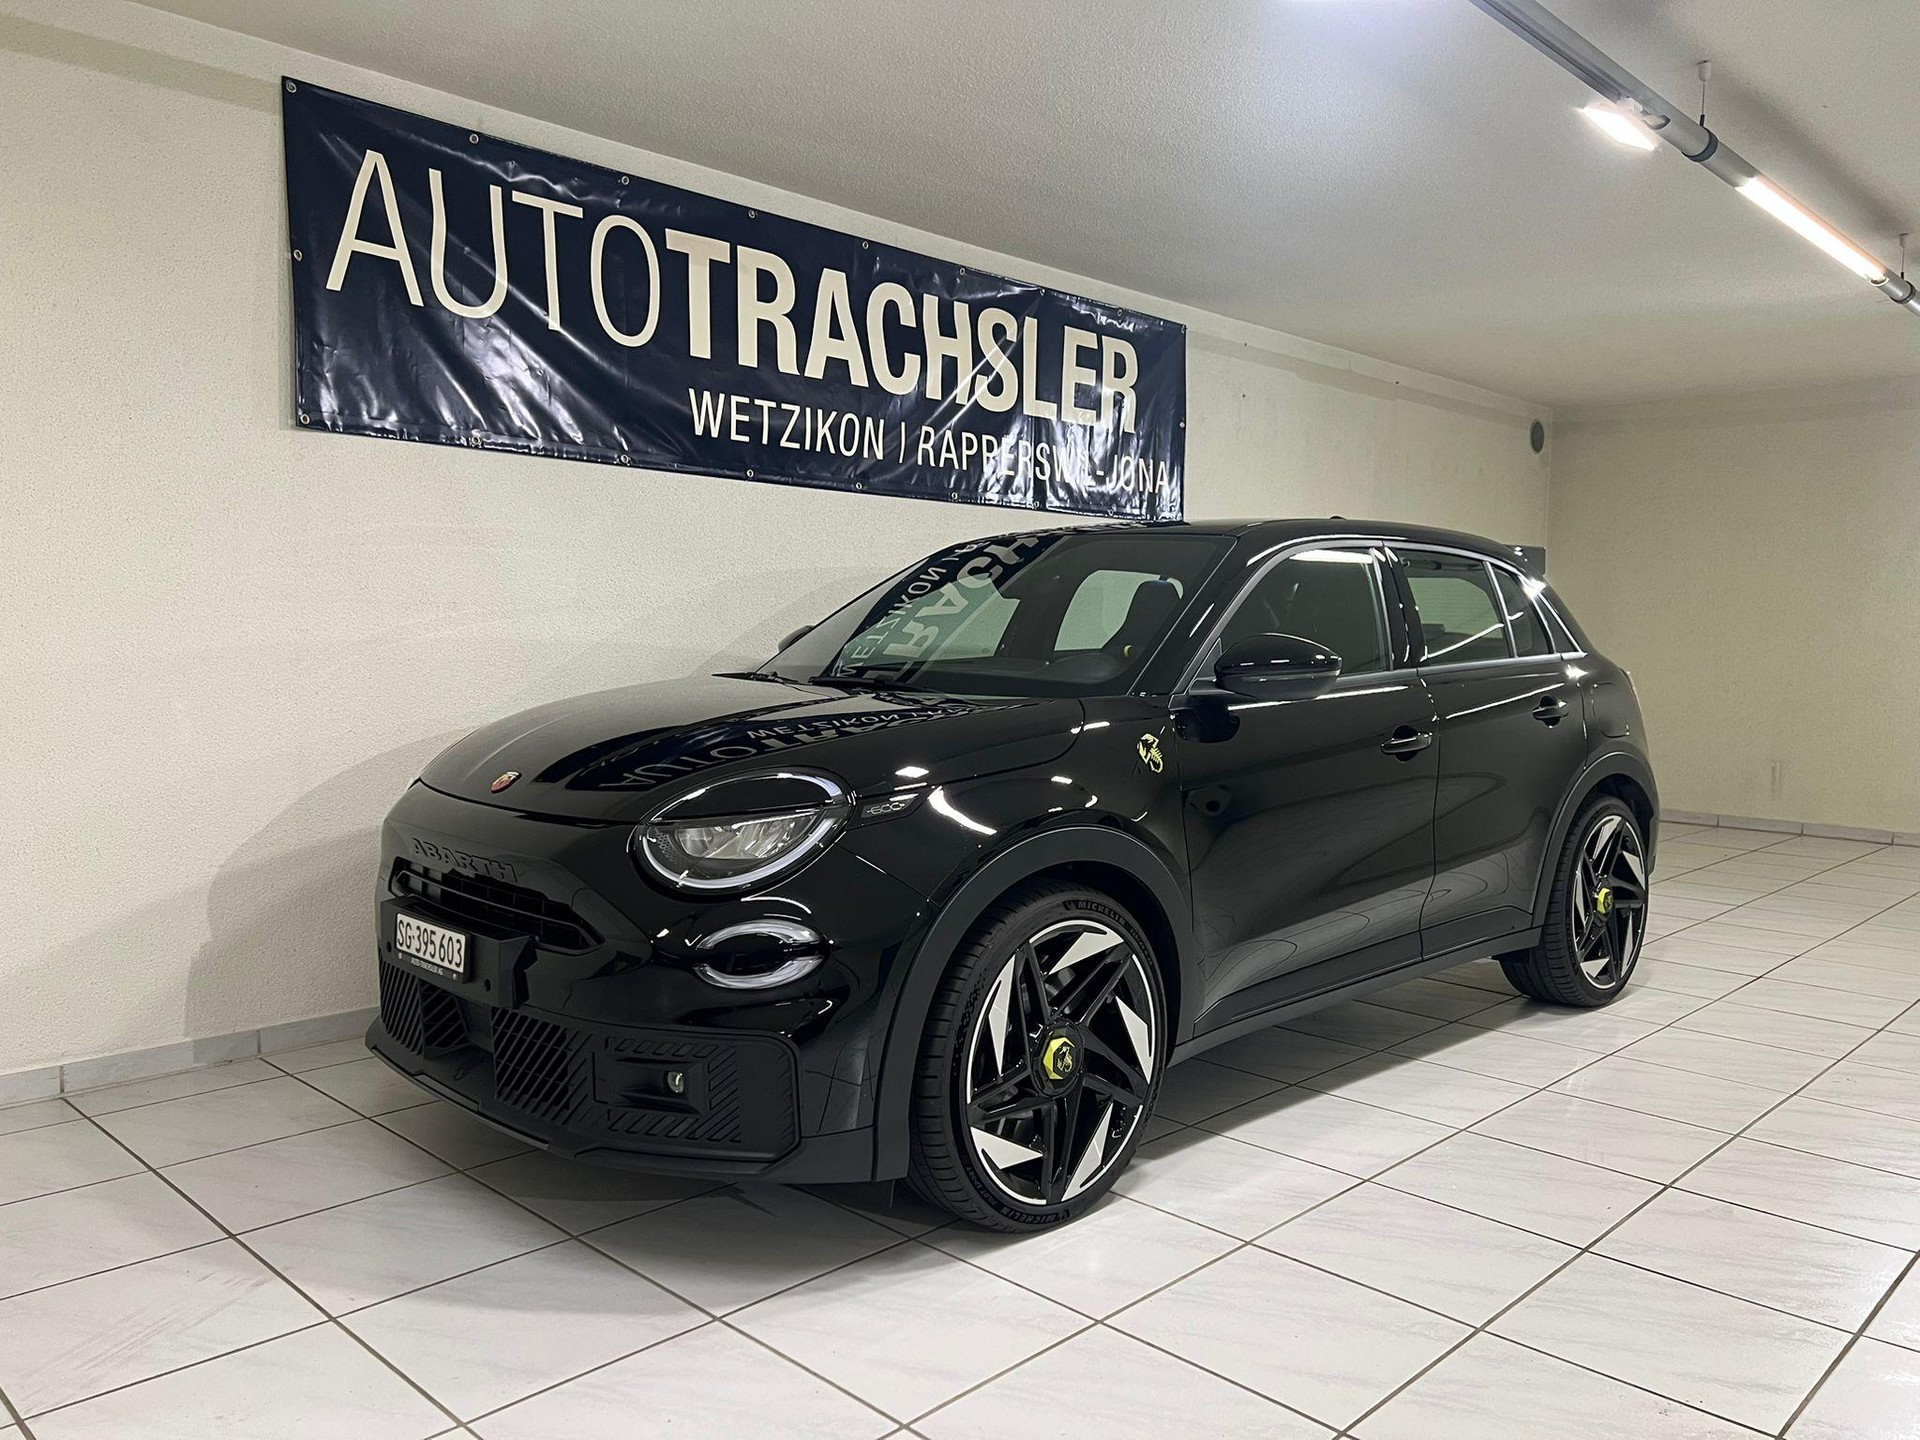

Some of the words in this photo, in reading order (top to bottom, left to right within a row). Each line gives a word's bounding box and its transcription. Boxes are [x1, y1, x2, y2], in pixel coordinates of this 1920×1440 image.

[689, 388, 884, 460] WETZIKON
[917, 425, 1169, 493] RAPPERSWL-JONA
[410, 837, 518, 882] ABARTH
[1077, 900, 1126, 925] MICHELIN
[1000, 1206, 1058, 1224] MICHELIN
